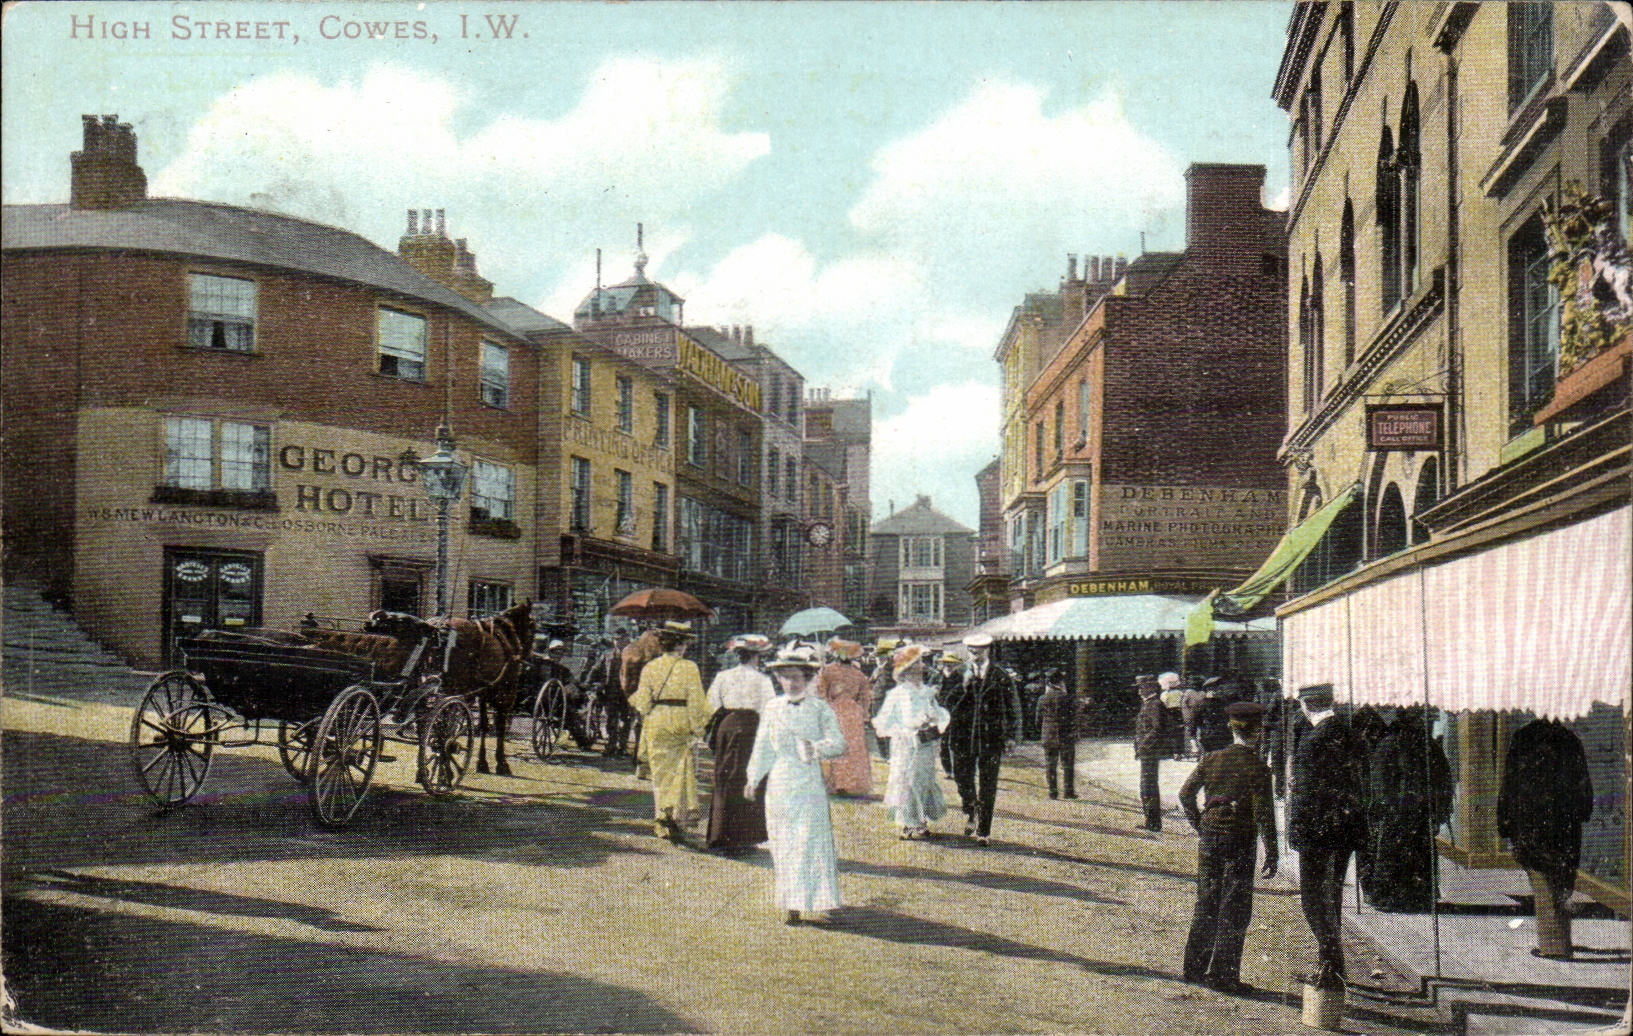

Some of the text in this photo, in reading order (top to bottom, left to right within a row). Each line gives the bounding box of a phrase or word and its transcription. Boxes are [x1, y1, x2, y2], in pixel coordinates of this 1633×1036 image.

[1376, 422, 1431, 435] TELEPHONE
[279, 445, 420, 482] GEORG
[295, 484, 429, 521] HOTEL
[1120, 486, 1282, 503] DEBENHAM
[1103, 520, 1163, 533] MARINE
